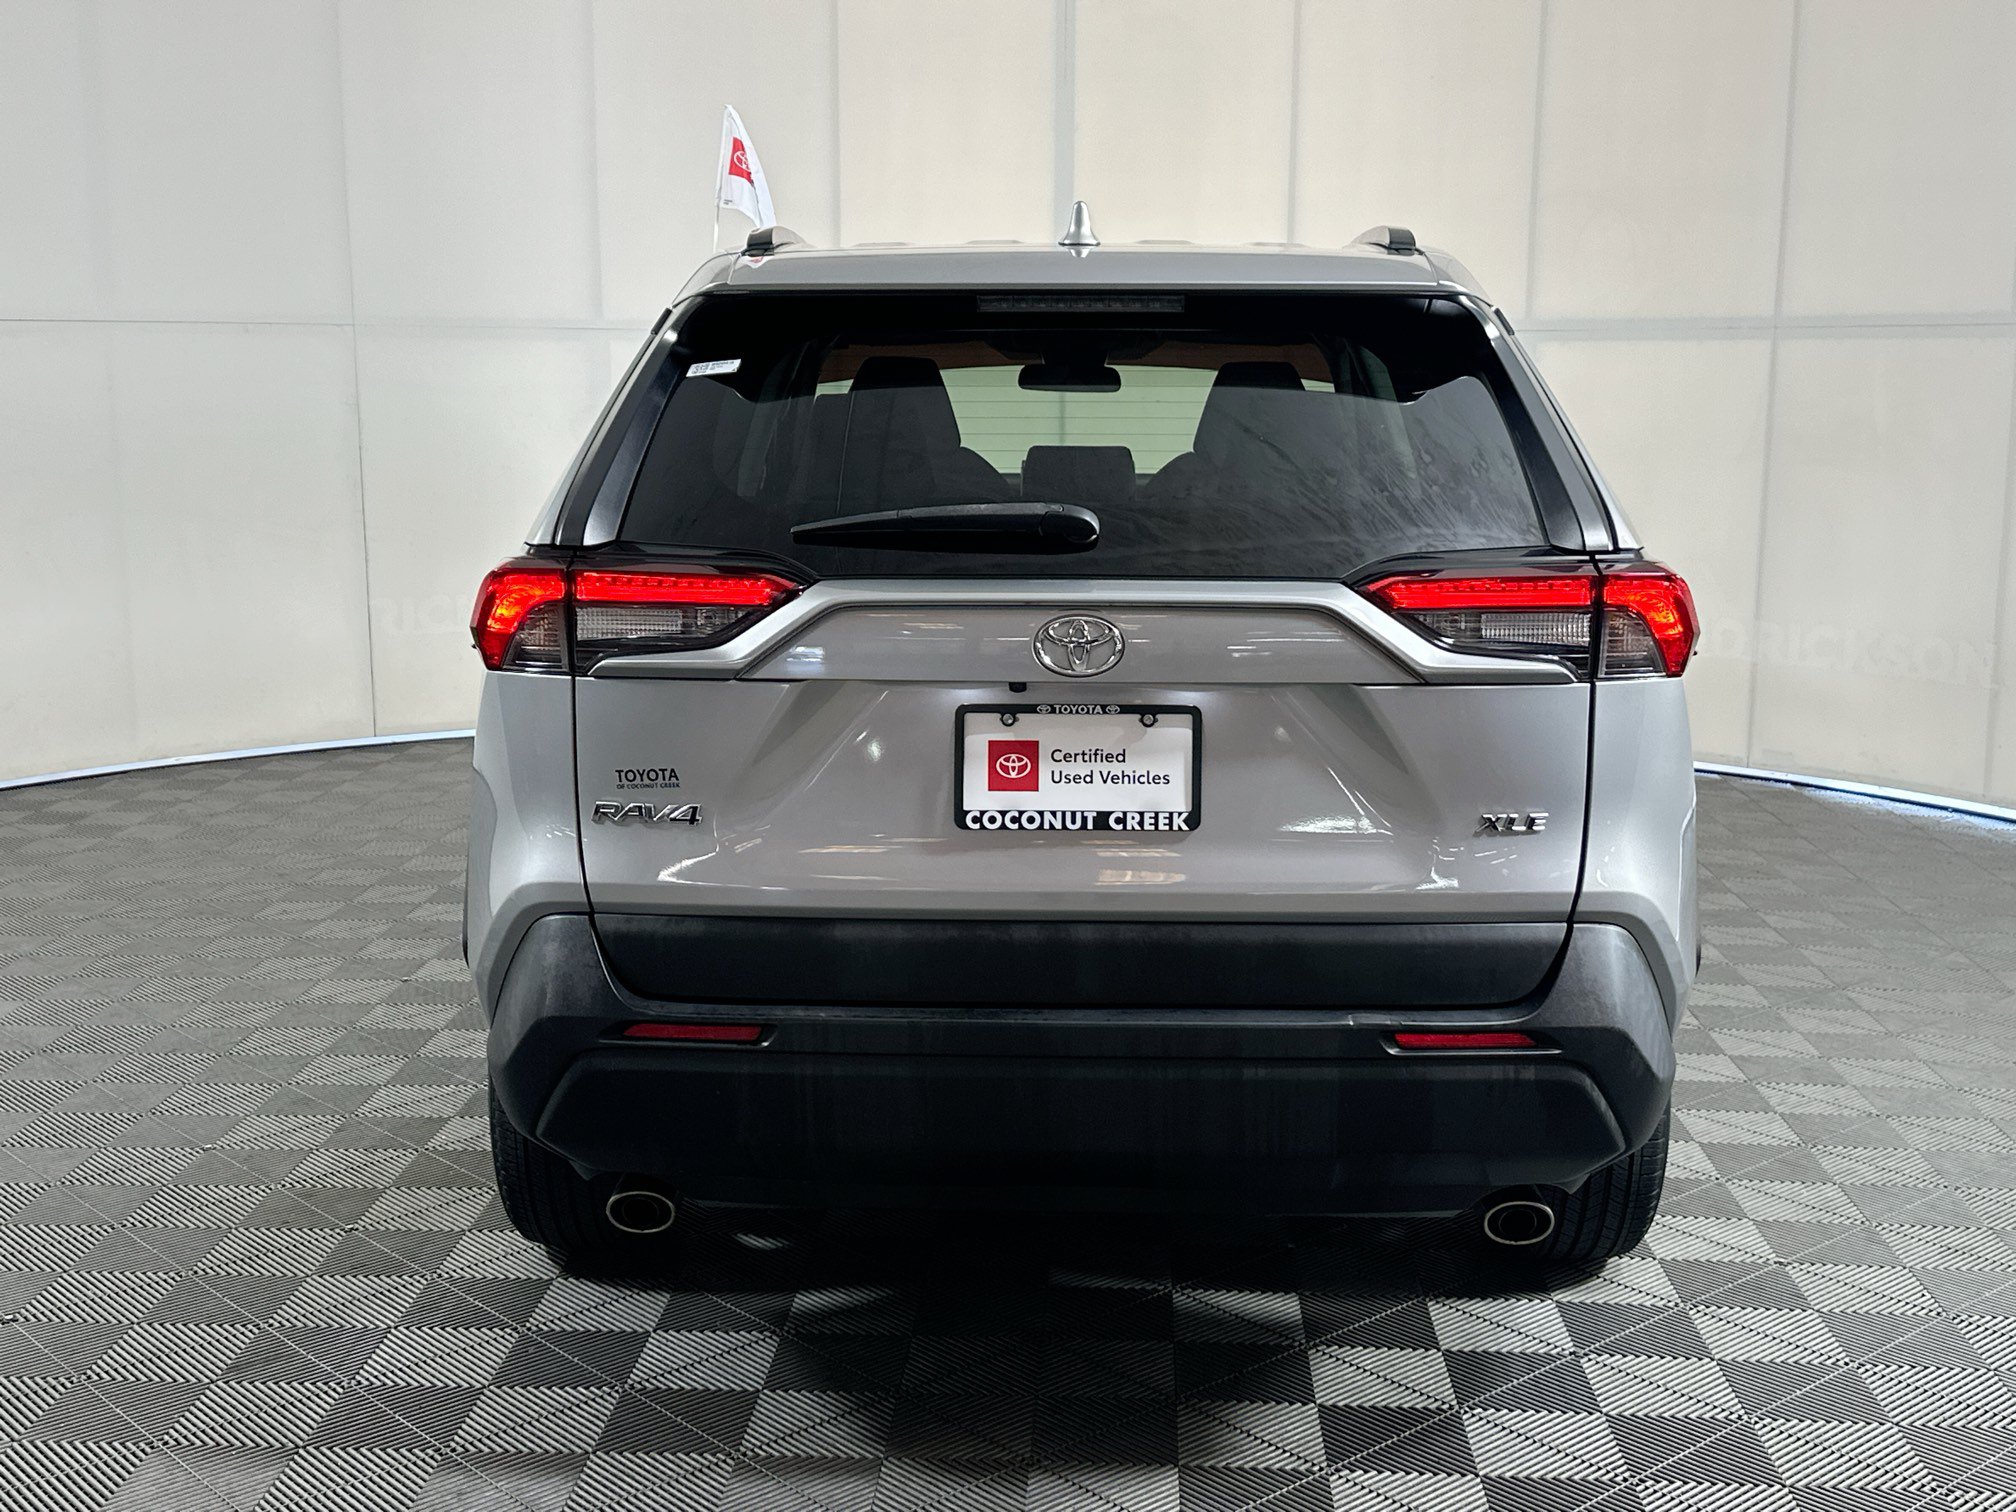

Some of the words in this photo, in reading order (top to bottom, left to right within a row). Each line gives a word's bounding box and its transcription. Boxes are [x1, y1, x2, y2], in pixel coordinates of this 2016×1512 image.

[1053, 704, 1103, 715] TOYOTA
[1050, 748, 1127, 764] Certified
[614, 767, 680, 783] TOYOTA
[1050, 770, 1094, 785] Used
[1098, 770, 1171, 785] Vehicles
[591, 800, 704, 826] RAV4
[964, 810, 1098, 830] COCONUT
[1108, 811, 1190, 832] CREEK
[1474, 812, 1549, 834] XLE
